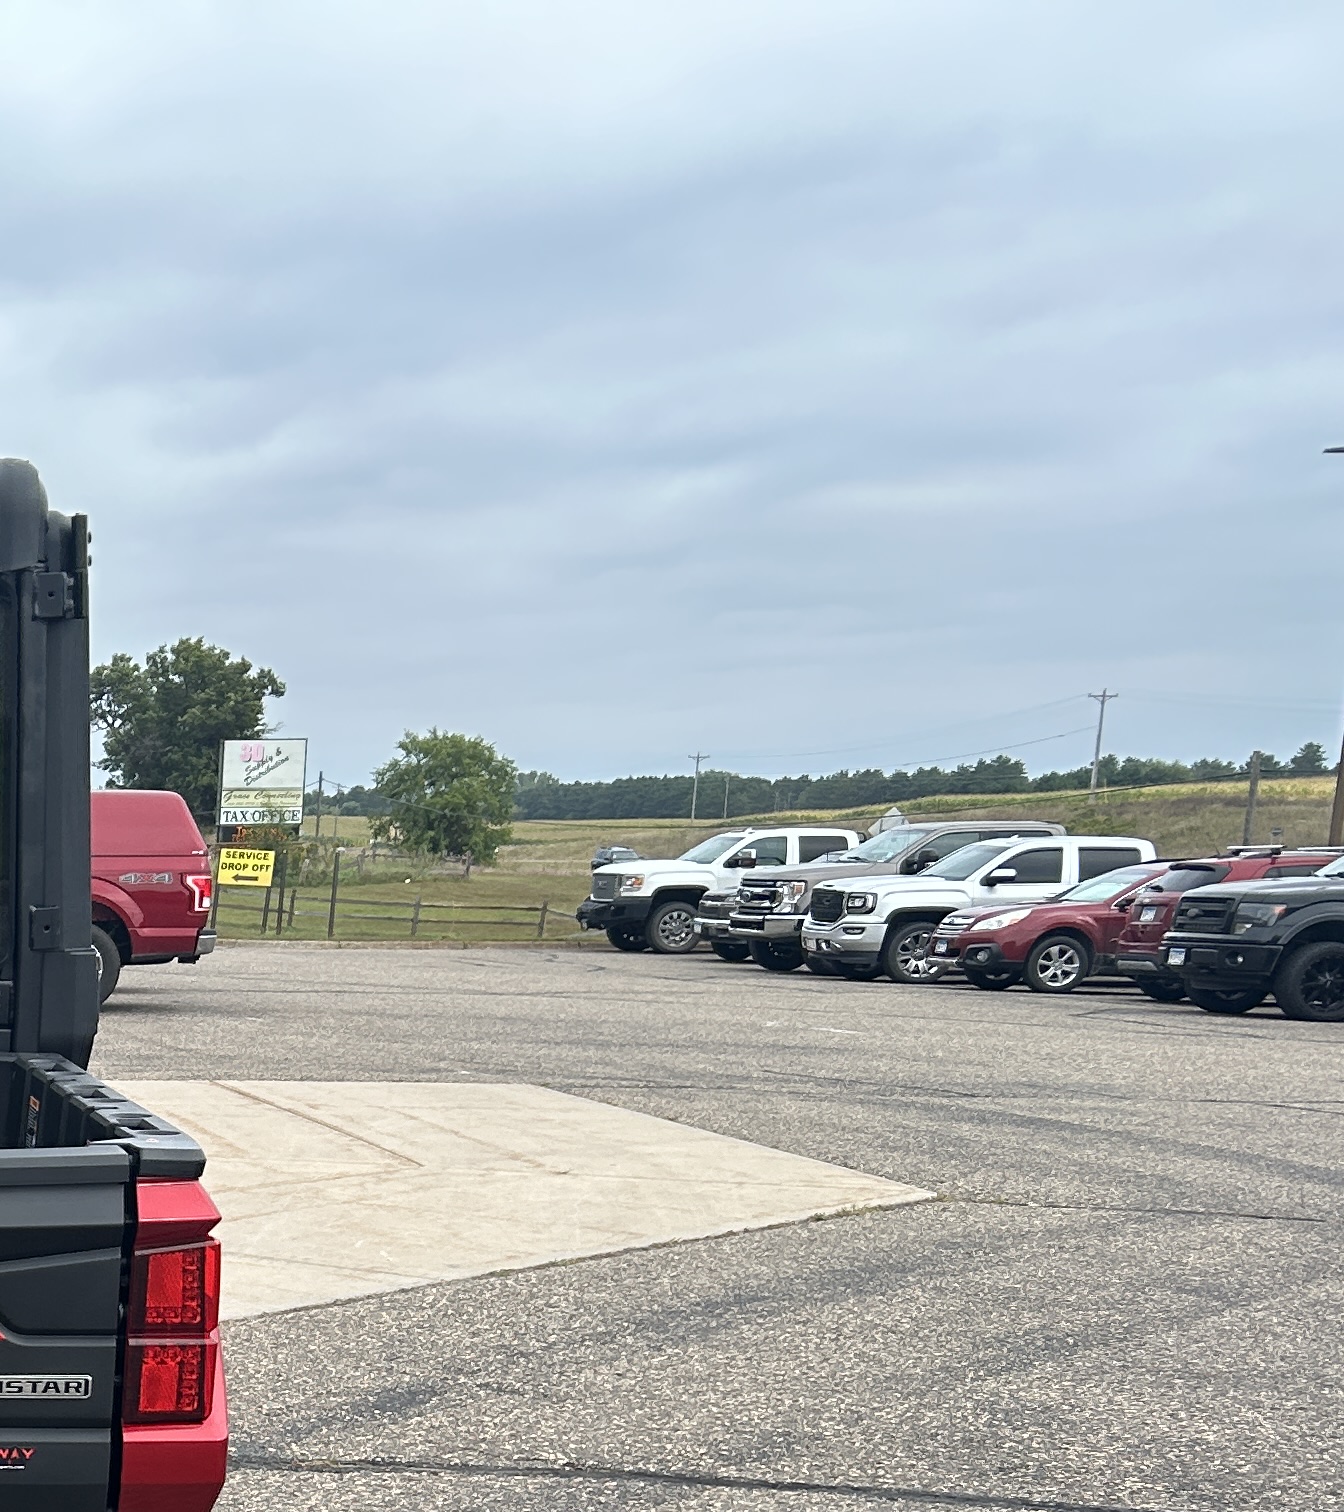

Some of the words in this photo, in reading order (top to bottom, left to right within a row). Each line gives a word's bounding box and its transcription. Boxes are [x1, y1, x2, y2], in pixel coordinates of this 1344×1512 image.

[223, 810, 249, 823] TAX
[252, 809, 301, 823] OFFICE
[225, 850, 270, 861] SERVICE
[221, 862, 249, 872] DROP
[251, 863, 271, 872] OFF
